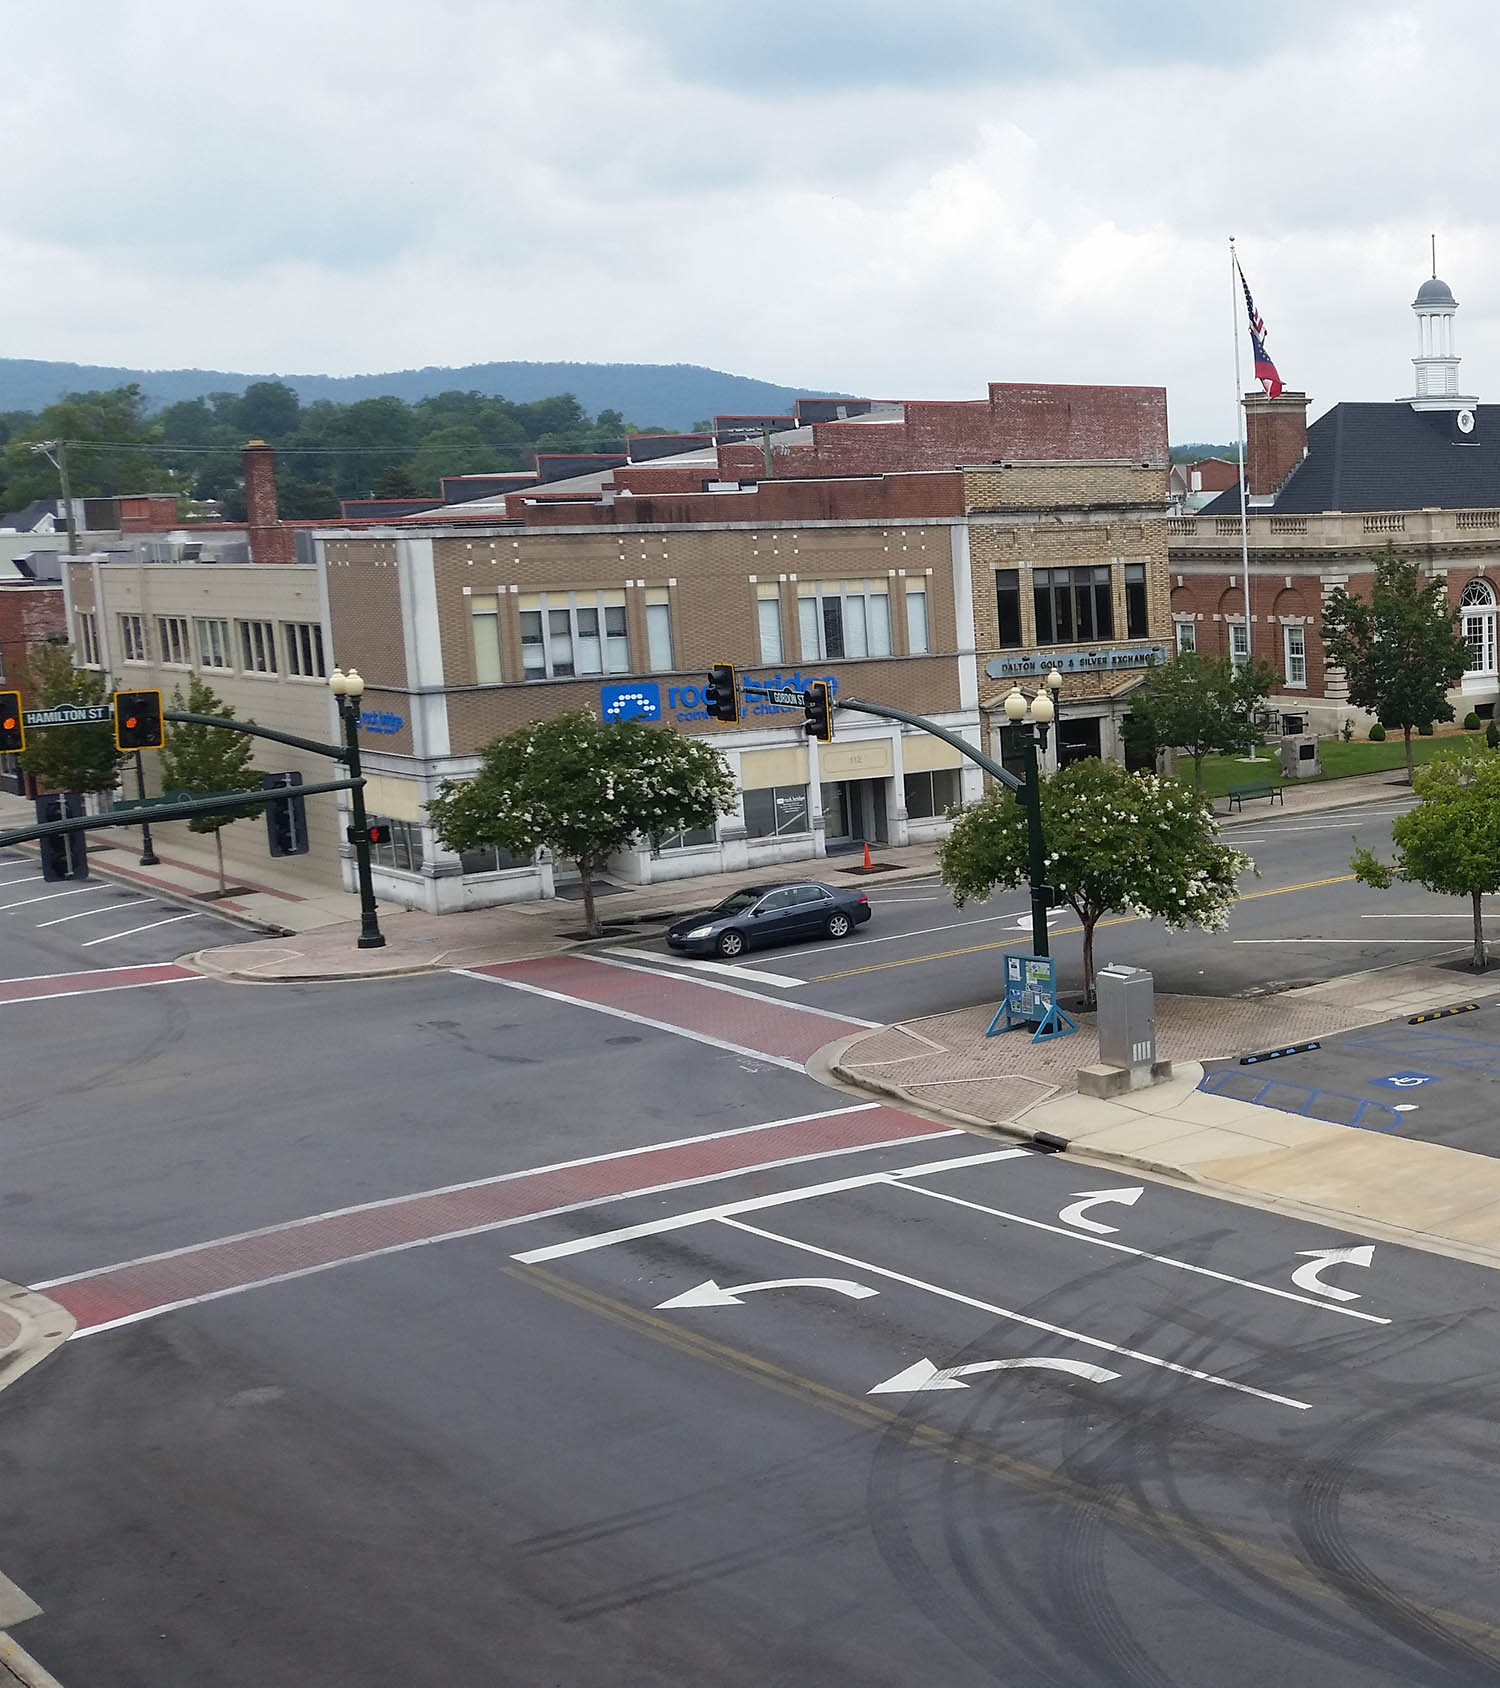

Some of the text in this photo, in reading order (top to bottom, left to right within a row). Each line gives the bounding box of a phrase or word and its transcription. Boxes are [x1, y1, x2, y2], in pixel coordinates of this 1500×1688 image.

[1001, 662, 1036, 673] DALTON
[1041, 659, 1064, 670] GOLD
[1080, 656, 1108, 666] SILVER
[774, 692, 798, 704] GORDON
[27, 708, 104, 724] HAMILTON ST
[850, 754, 863, 764] 112
